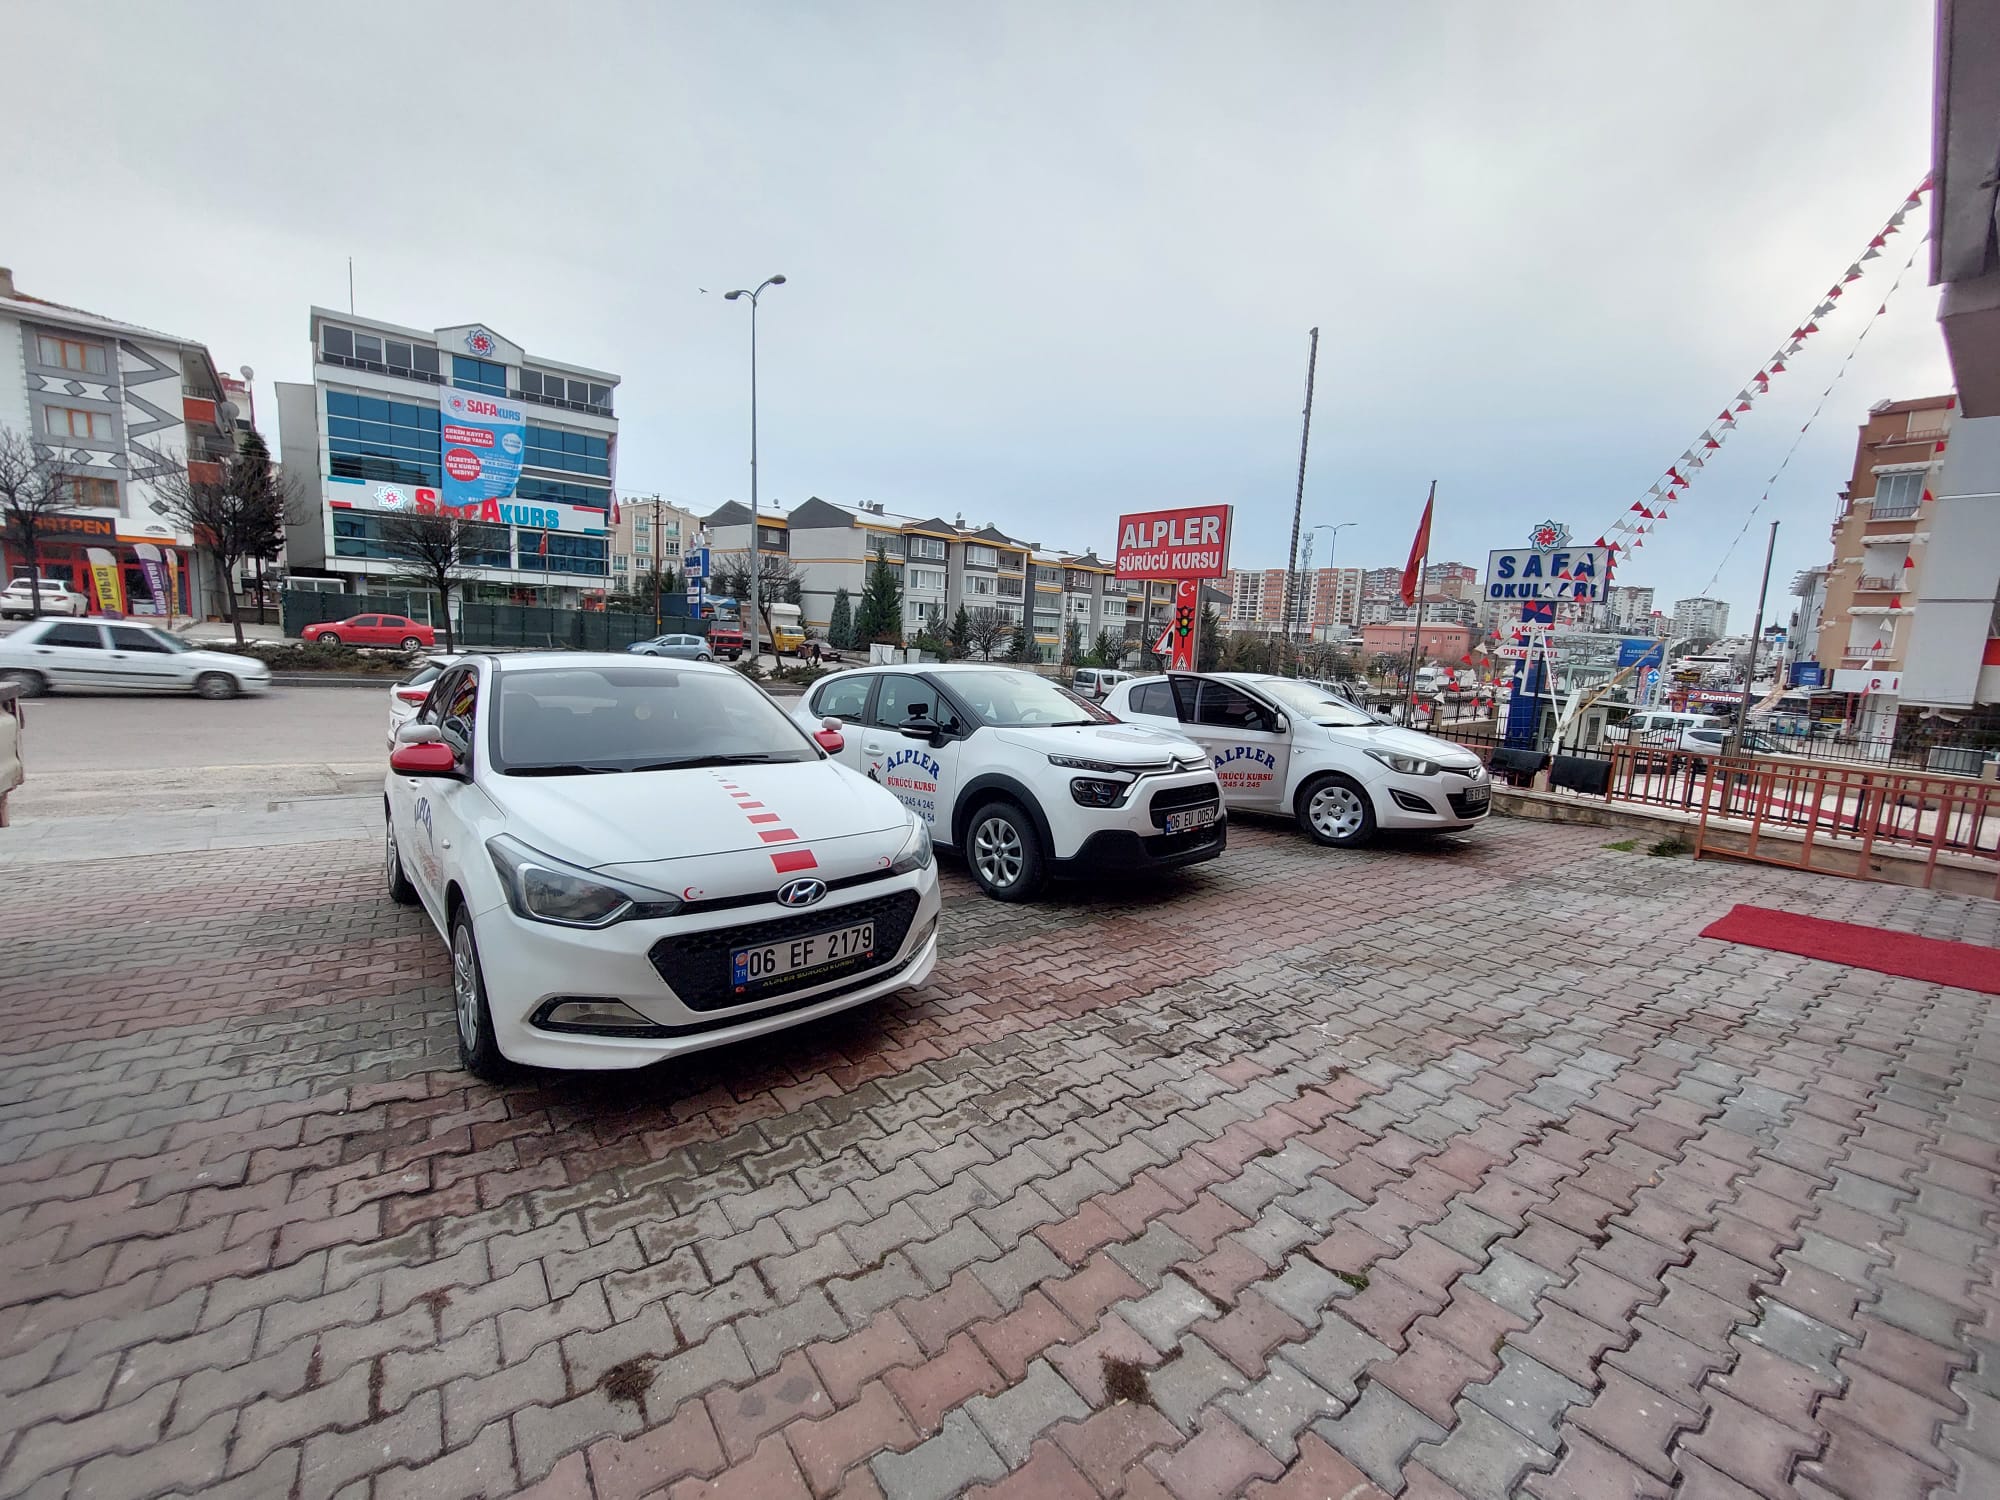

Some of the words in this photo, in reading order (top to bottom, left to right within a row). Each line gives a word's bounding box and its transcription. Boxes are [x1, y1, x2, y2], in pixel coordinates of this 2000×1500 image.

[1120, 515, 1221, 550] ALPLER
[1119, 551, 1168, 571] SÜRÜCÜ
[1171, 551, 1220, 570] KURSU
[1497, 553, 1596, 579] SAFA
[886, 749, 940, 780] ALPLER
[1214, 746, 1276, 770] ALPLER
[887, 775, 913, 789] SÜRÜCÜ
[913, 780, 937, 793] KURSU
[1217, 771, 1245, 780] ÜRÜCÜ
[1246, 772, 1274, 781] KURSU
[905, 795, 916, 807] 245
[917, 798, 922, 807] 4
[923, 799, 935, 810] 245
[927, 812, 936, 823] 54
[1171, 814, 1180, 829] 06
[1184, 811, 1194, 827] EU
[1197, 806, 1214, 824] 0052
[749, 948, 776, 977] 06
[790, 939, 815, 968] EF
[827, 926, 873, 959] 2179
[735, 968, 747, 977] TR
[762, 975, 795, 987] ALPLER
